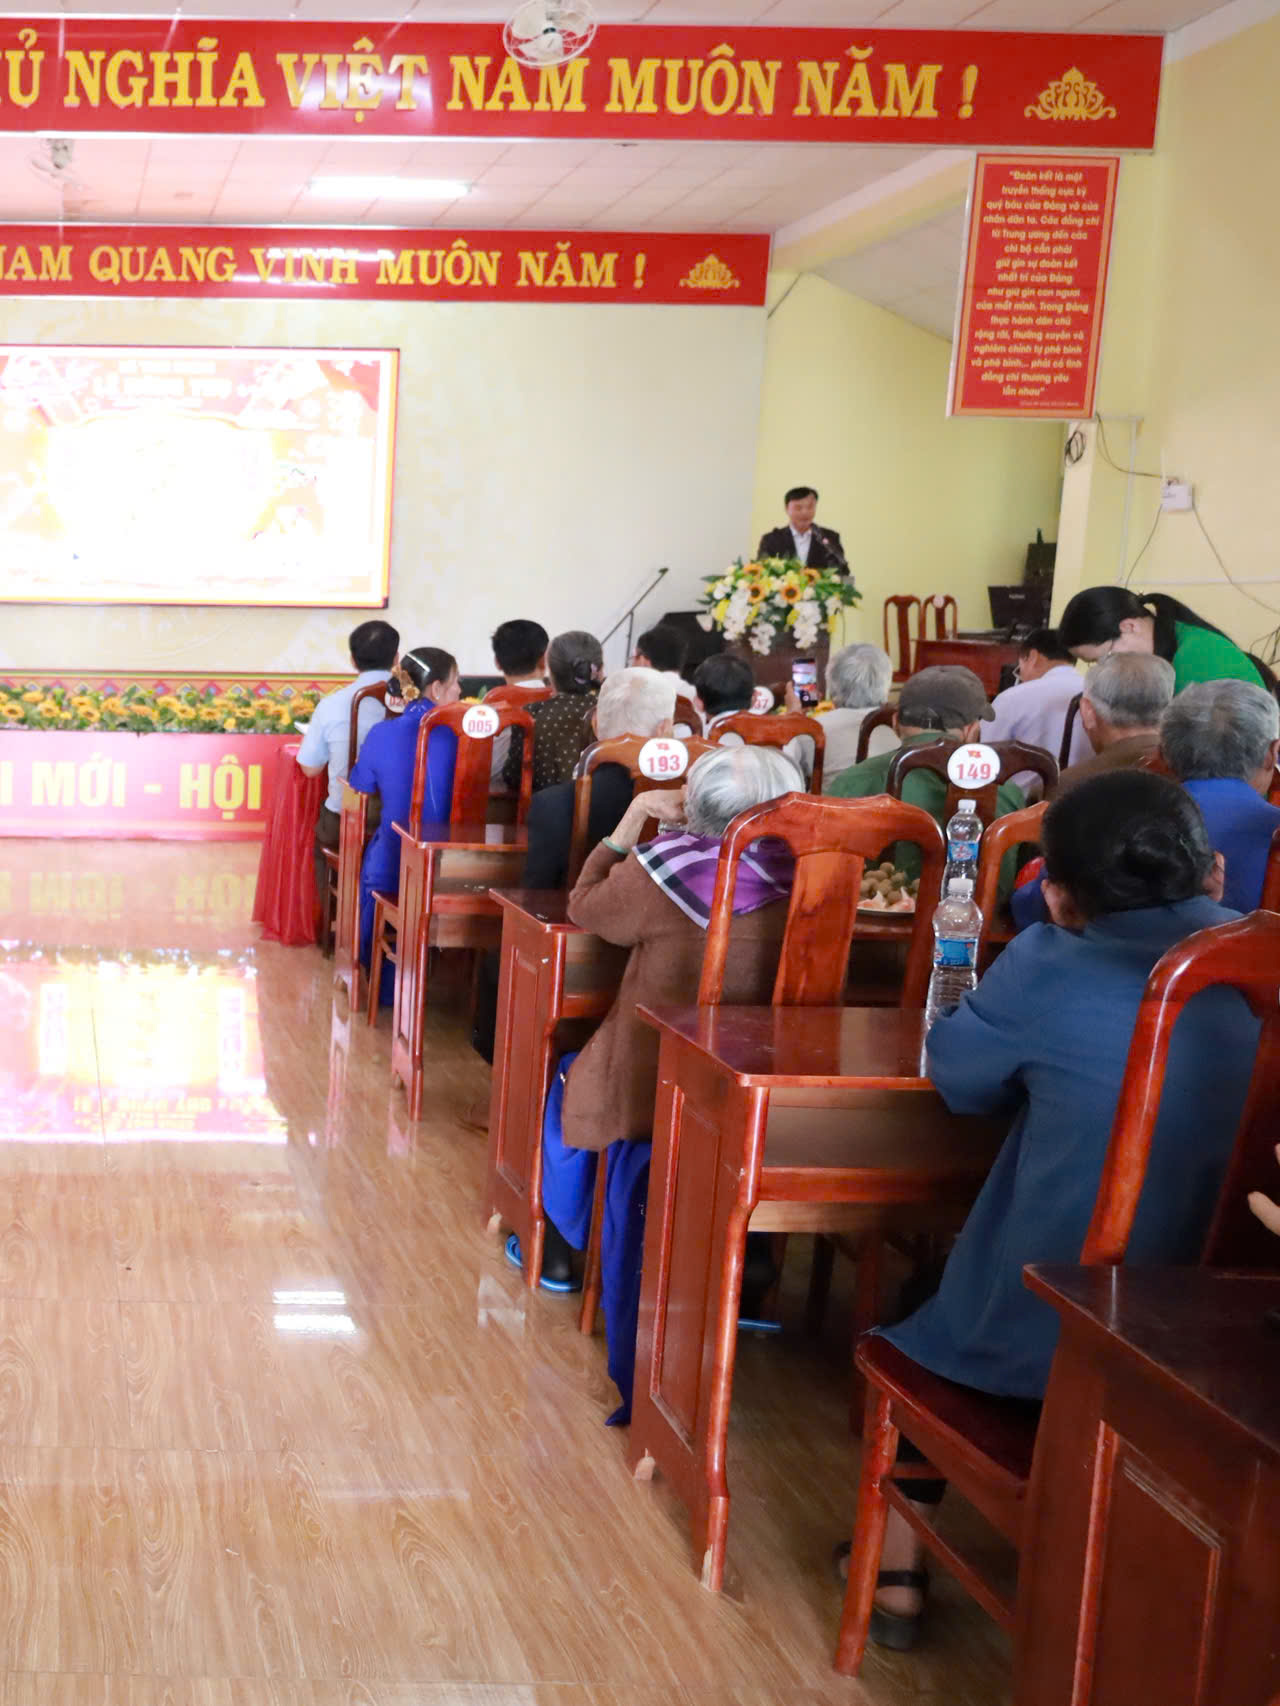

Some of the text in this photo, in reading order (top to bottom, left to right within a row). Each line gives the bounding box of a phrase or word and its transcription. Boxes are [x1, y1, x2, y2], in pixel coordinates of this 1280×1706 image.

[63, 37, 266, 108] NGHĨA
[276, 37, 429, 122] VIỆT
[446, 55, 586, 112] NAM
[605, 43, 781, 115] MUÔN
[793, 45, 942, 118] NĂM
[958, 64, 978, 119] !
[89, 245, 238, 285] QUANG
[250, 248, 360, 284] VINH
[376, 238, 501, 286] MUÔN
[516, 241, 618, 288] NĂM
[634, 253, 647, 289] !
[468, 719, 493, 734] 005
[647, 754, 681, 774] 193
[955, 763, 992, 780] 149
[30, 751, 126, 807] MỚI
[179, 754, 263, 820] HỘI
